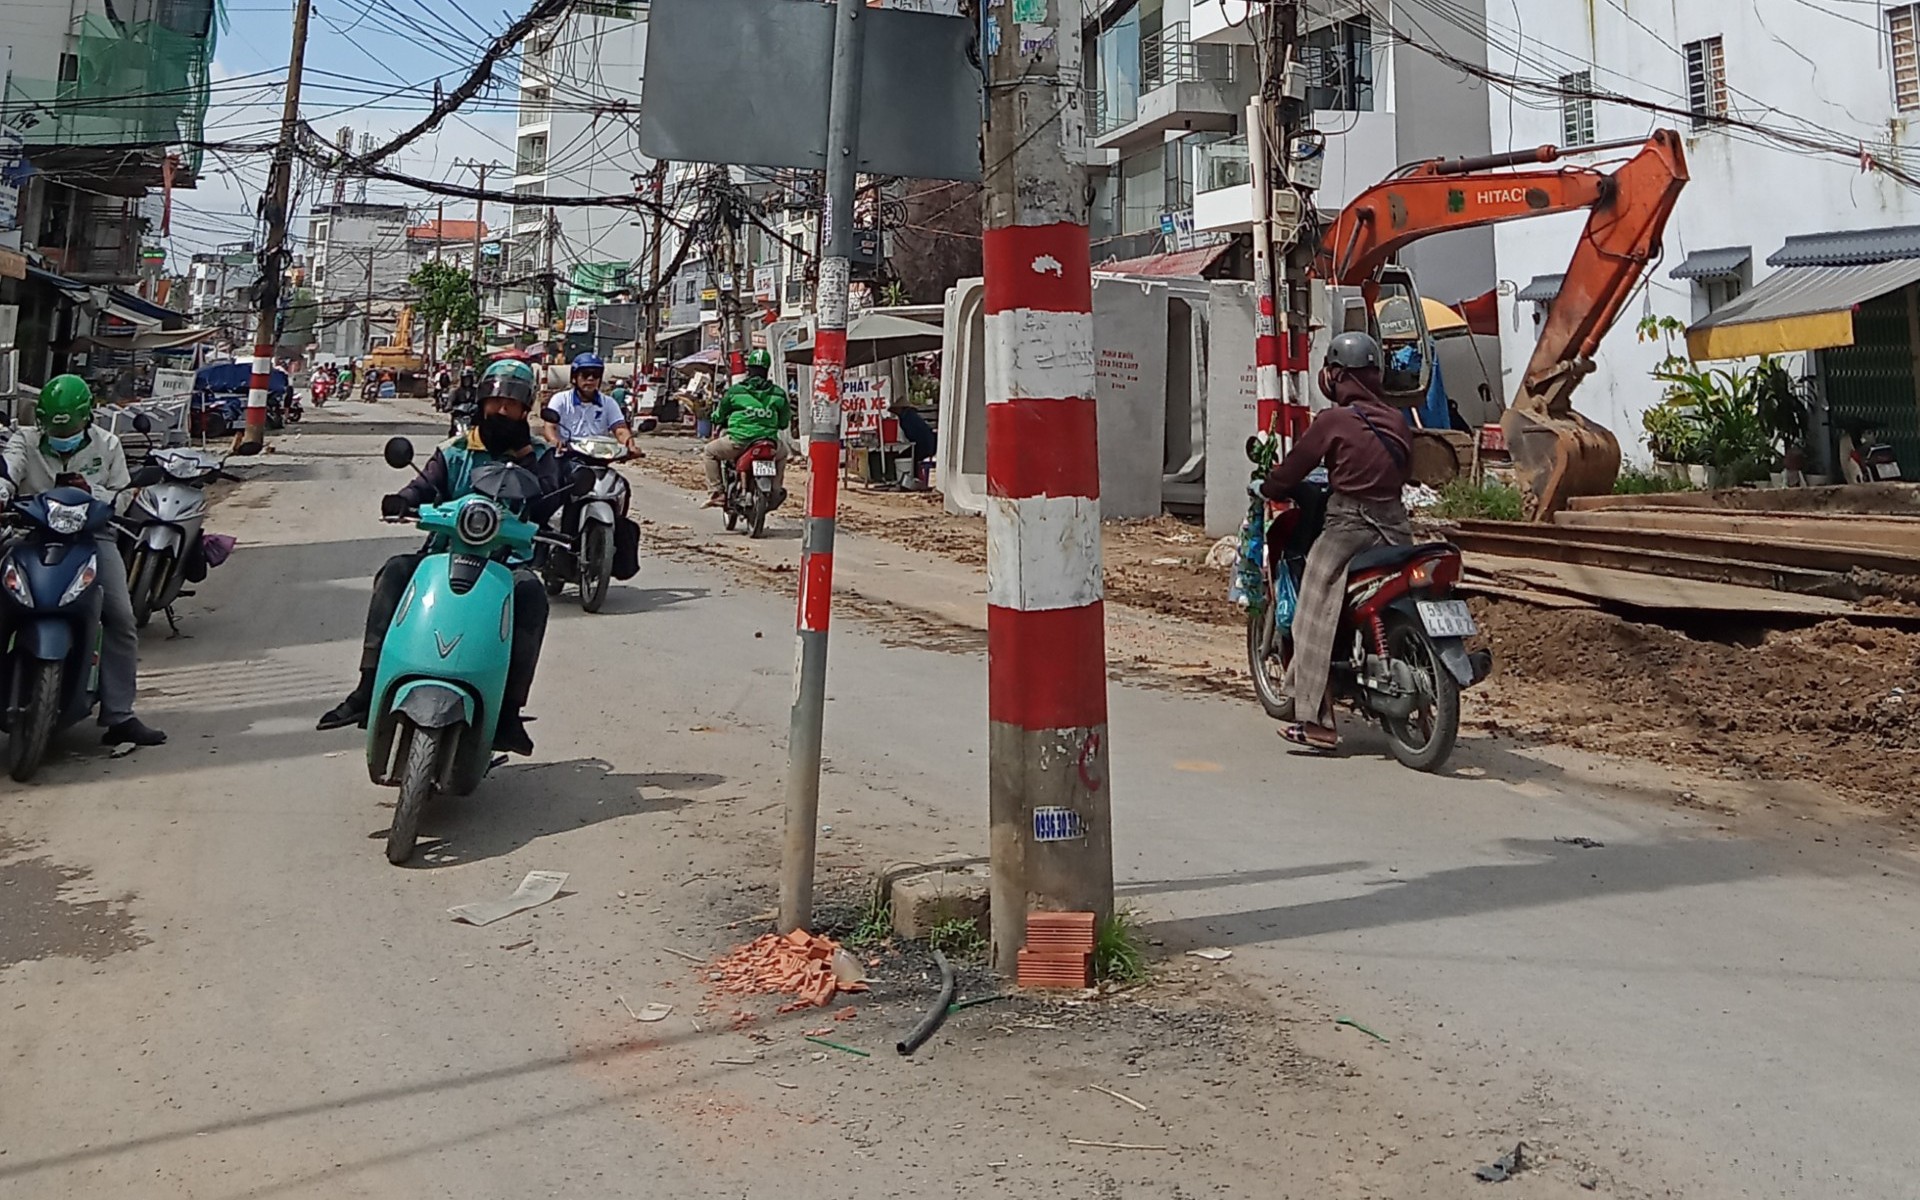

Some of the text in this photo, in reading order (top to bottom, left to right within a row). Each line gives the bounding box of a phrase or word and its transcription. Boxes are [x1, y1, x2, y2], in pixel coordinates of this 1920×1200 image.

[842, 394, 886, 412] SỬA XE
[744, 405, 773, 418] Grab
